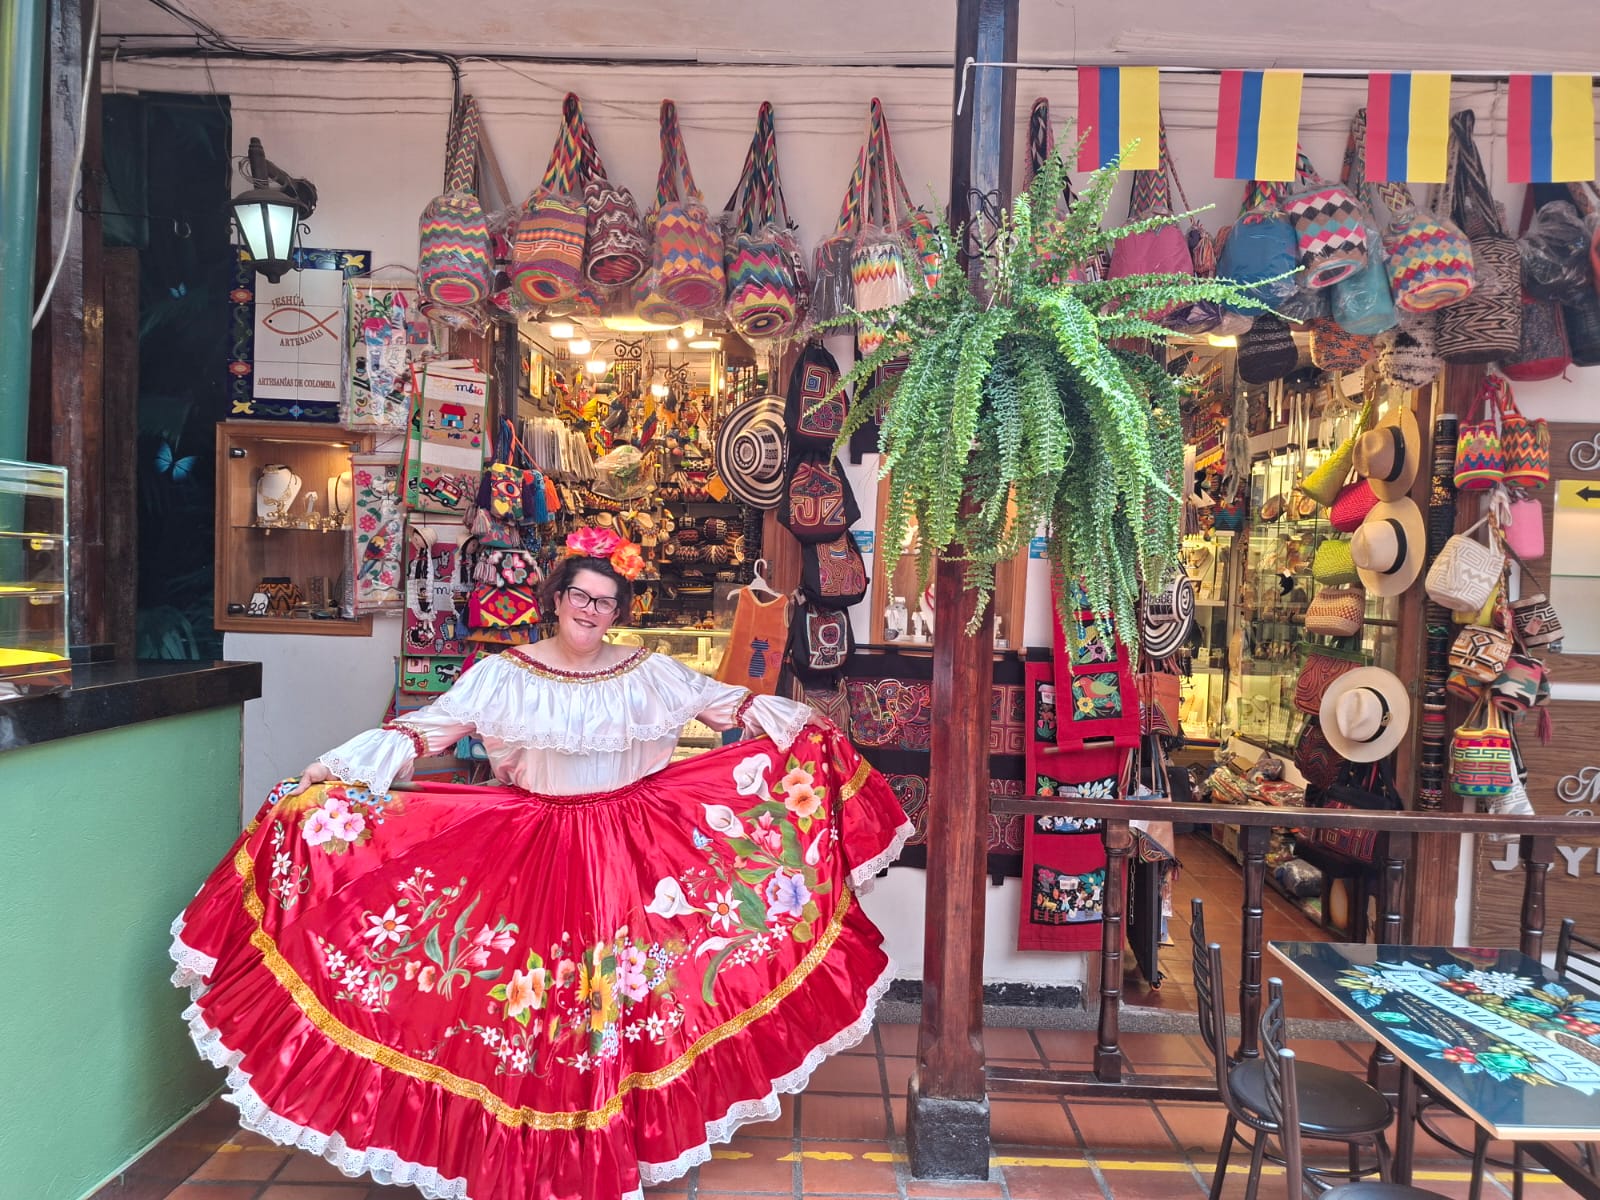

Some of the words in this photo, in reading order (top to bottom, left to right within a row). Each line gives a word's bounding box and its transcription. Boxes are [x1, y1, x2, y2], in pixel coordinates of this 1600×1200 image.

[280, 329, 324, 346] ARTESANÍAS
[257, 376, 294, 387] ARTESANÍAS
[294, 379, 303, 387] DE
[304, 379, 336, 389] COLOMBIA
[1391, 974, 1419, 983] LA
[1407, 984, 1513, 1032] ESMERALDA
[1521, 1041, 1557, 1052] EL
